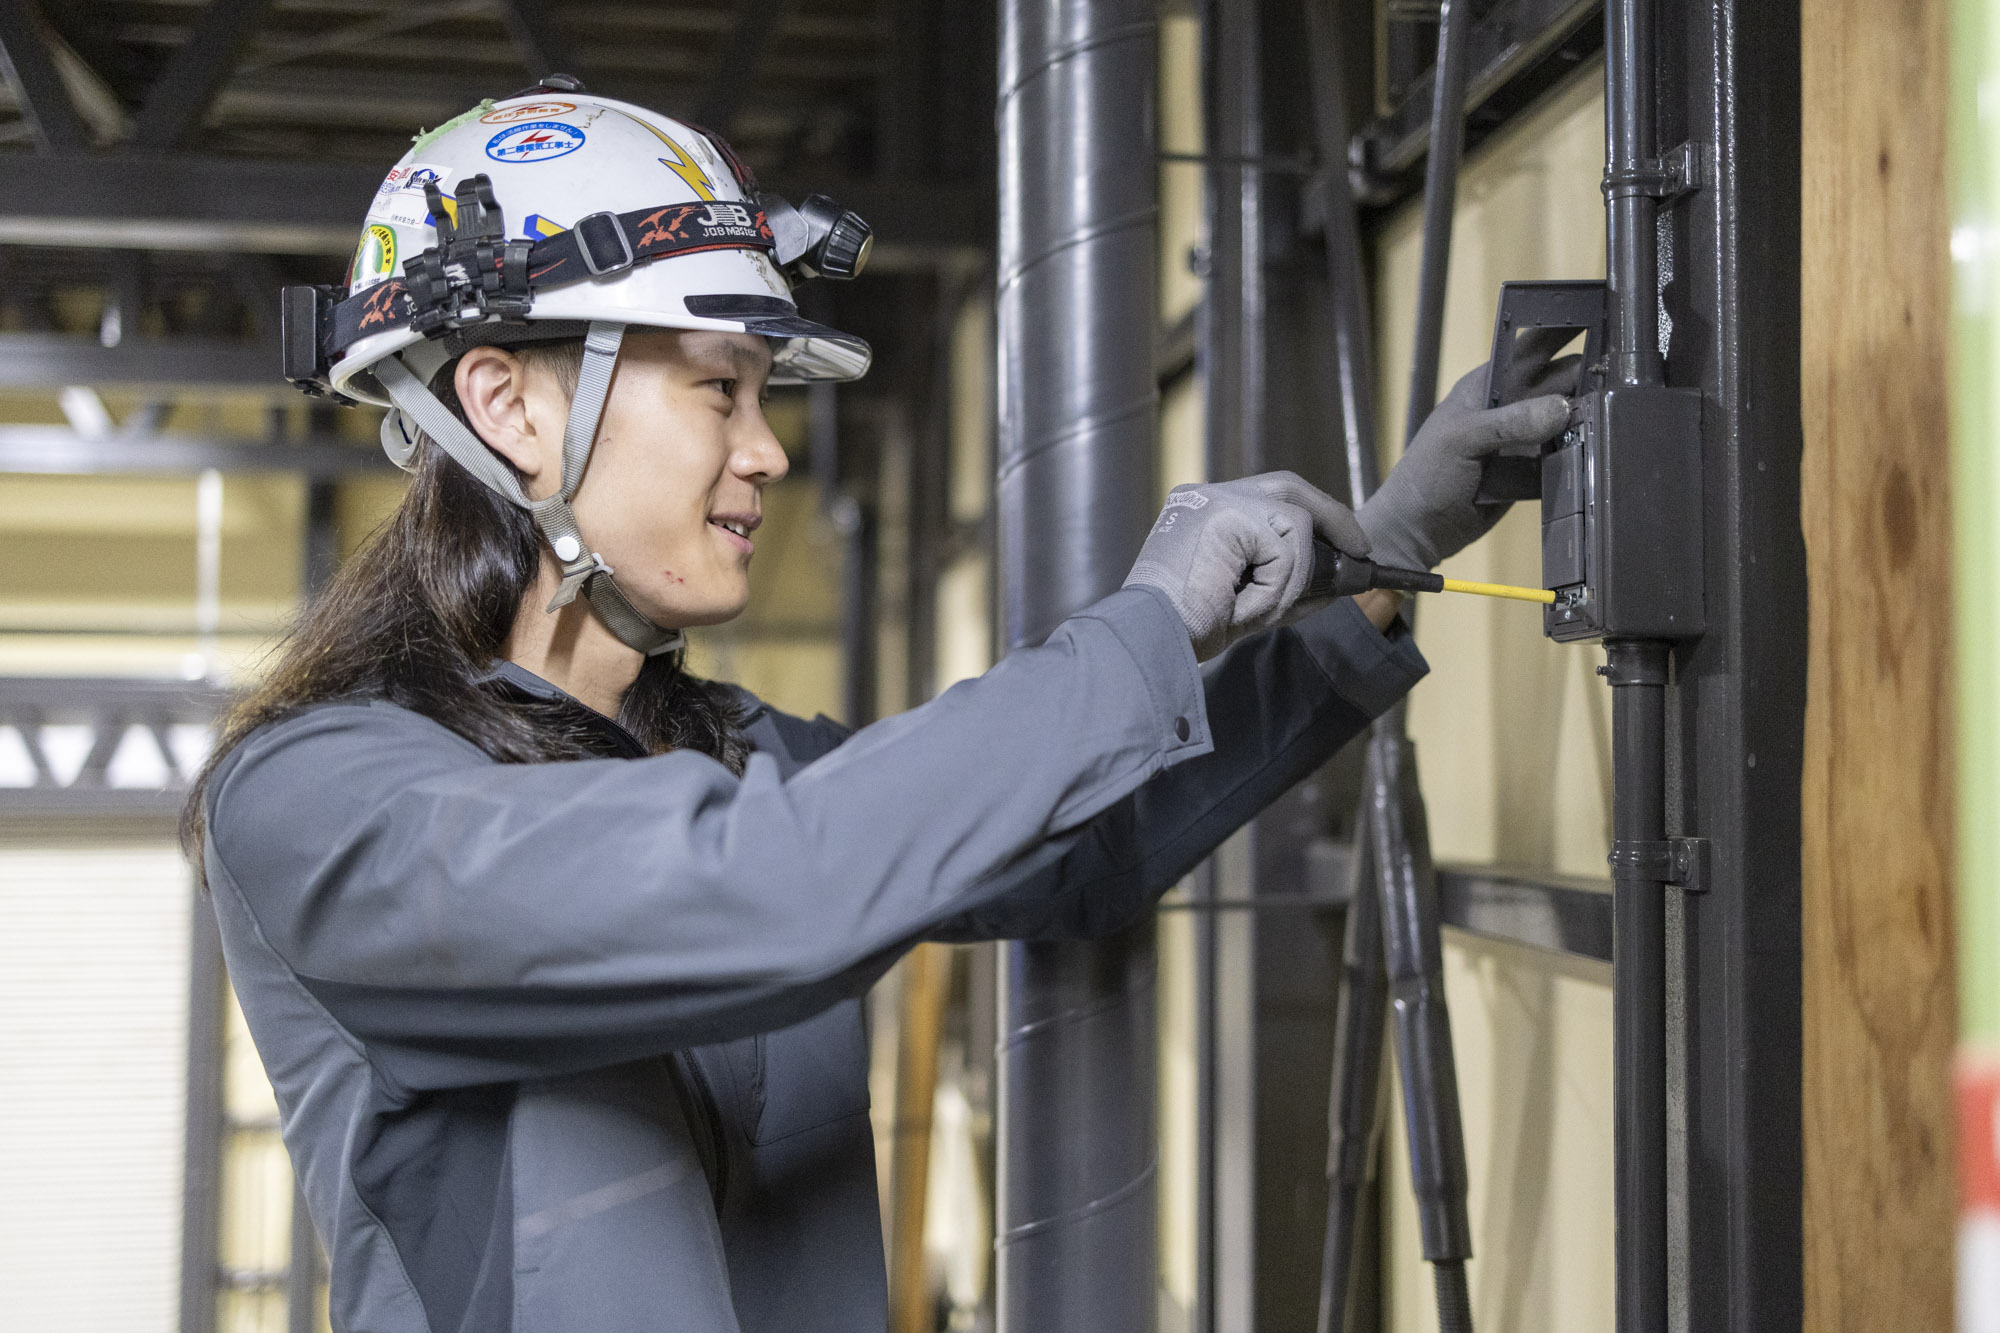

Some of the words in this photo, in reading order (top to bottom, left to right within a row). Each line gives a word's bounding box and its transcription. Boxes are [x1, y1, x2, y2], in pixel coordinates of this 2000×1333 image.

[497, 141, 574, 157] 第二種電気工事士
[702, 227, 726, 237] JOB
[726, 226, 757, 237] Master
